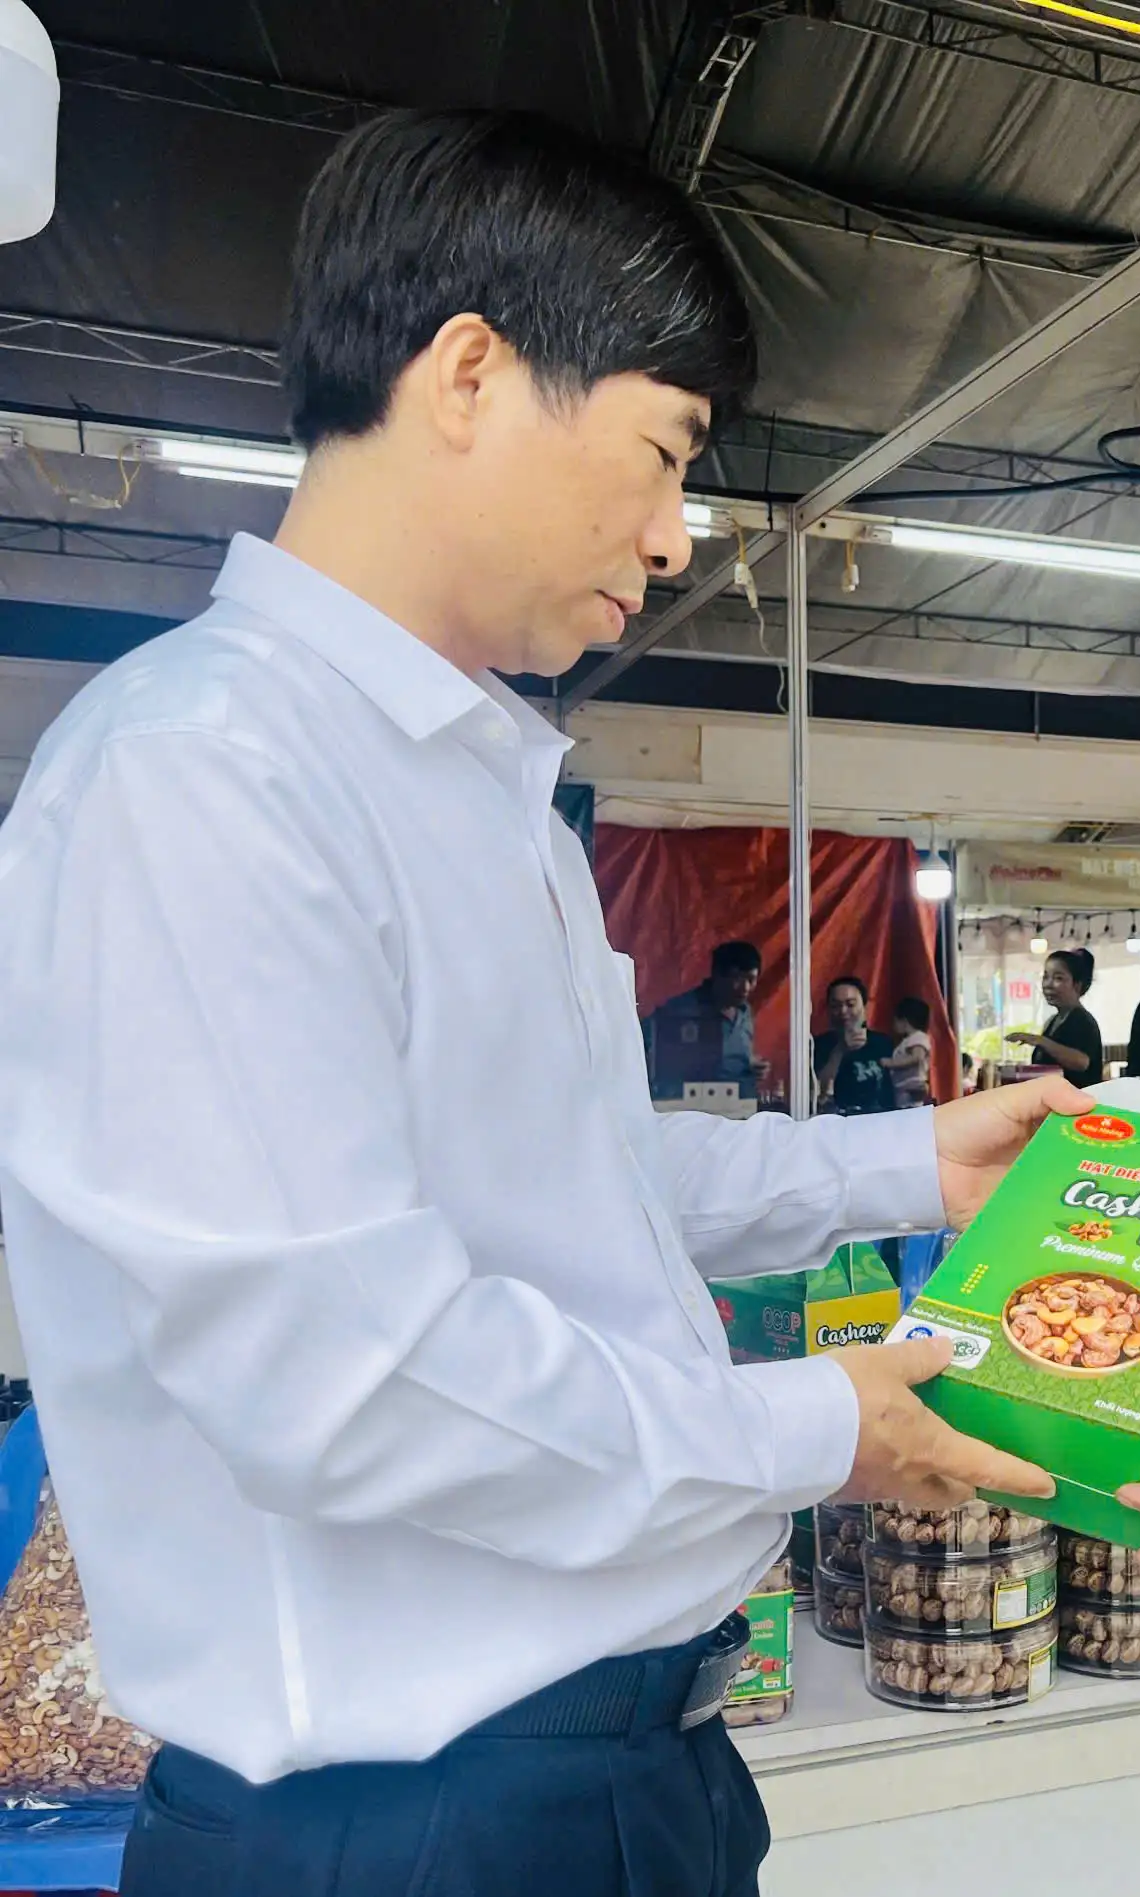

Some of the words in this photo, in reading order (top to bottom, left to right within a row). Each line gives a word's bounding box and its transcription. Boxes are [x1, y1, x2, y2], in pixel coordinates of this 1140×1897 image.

[1077, 1159, 1114, 1175] HẠT
[762, 1306, 802, 1334] OCOP
[817, 1322, 885, 1347] Cashew
